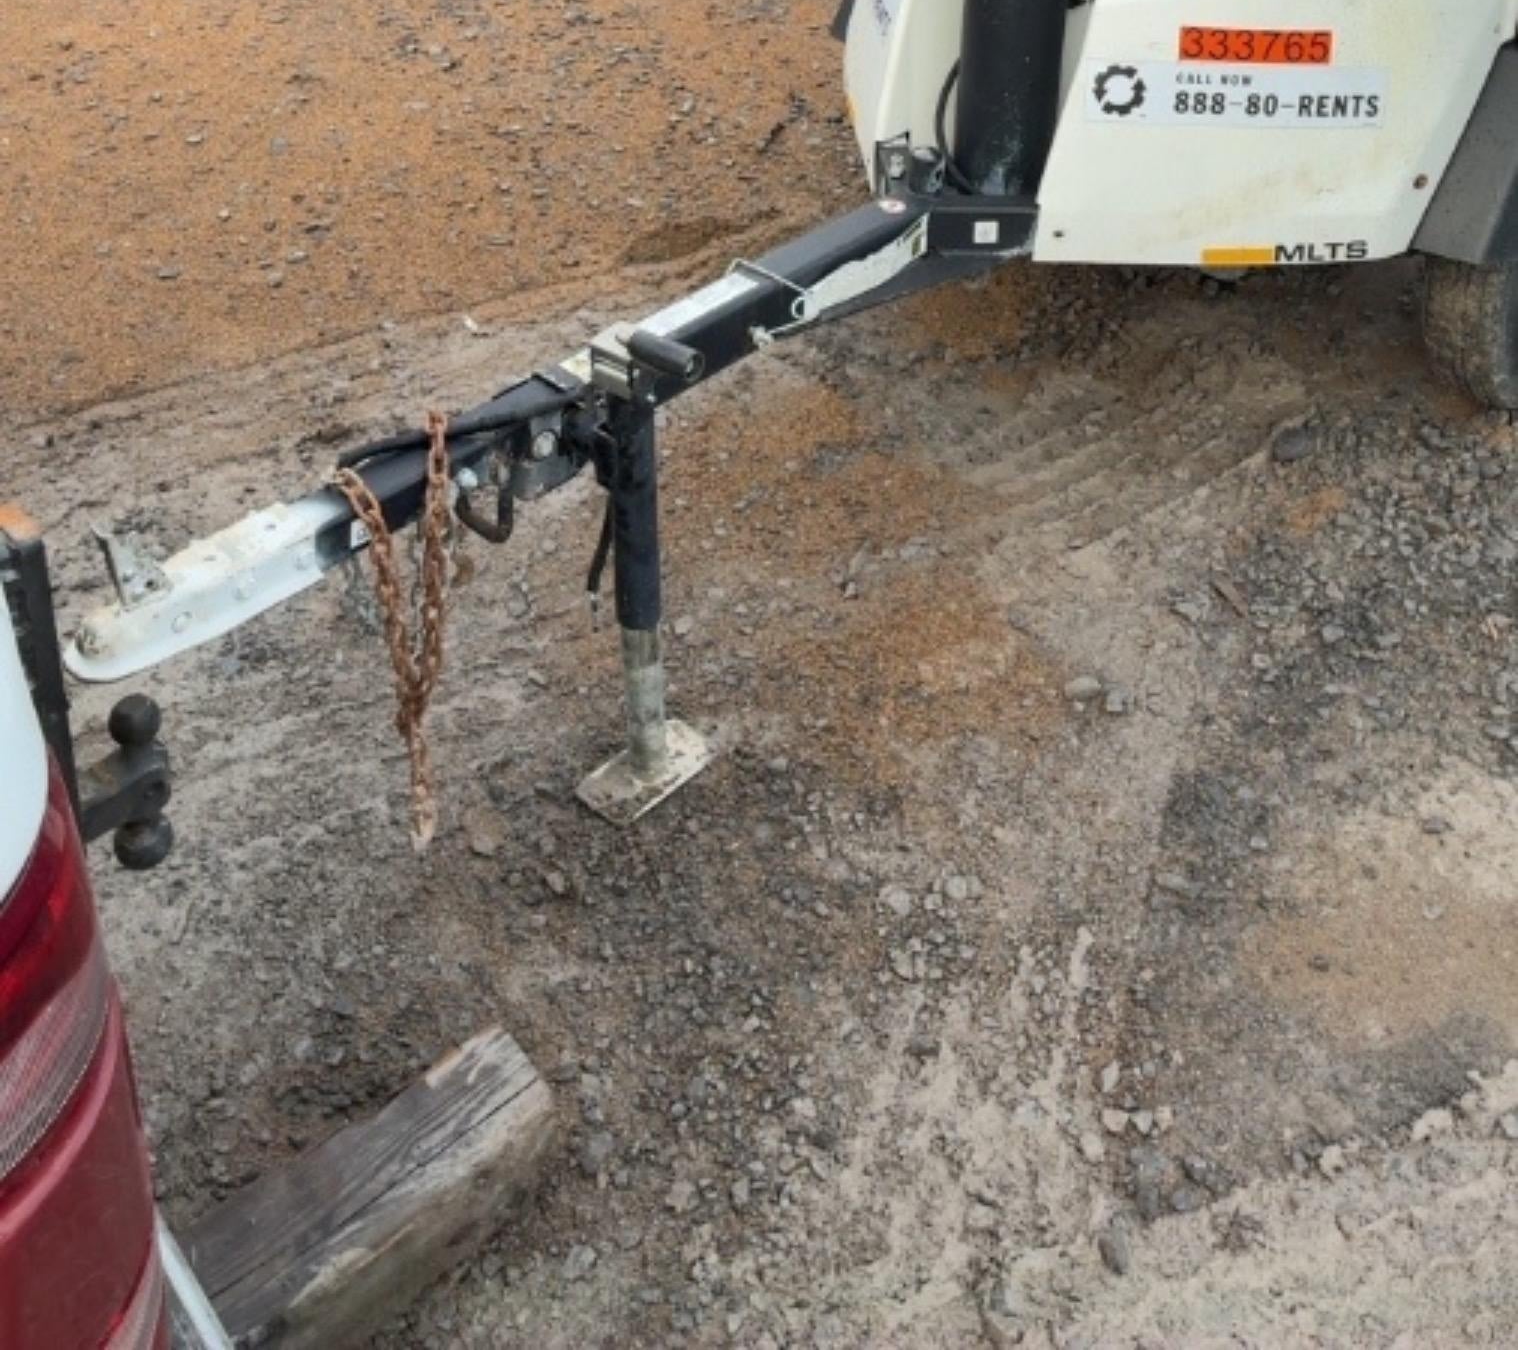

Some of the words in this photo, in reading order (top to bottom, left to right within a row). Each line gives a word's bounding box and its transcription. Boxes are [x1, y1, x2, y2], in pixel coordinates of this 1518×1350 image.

[1182, 28, 1330, 62] 333765
[1176, 72, 1212, 85] CALL
[1220, 73, 1252, 86] NOW
[1174, 90, 1379, 118] 888-80-RENTS
[1274, 240, 1368, 262] MLTS
